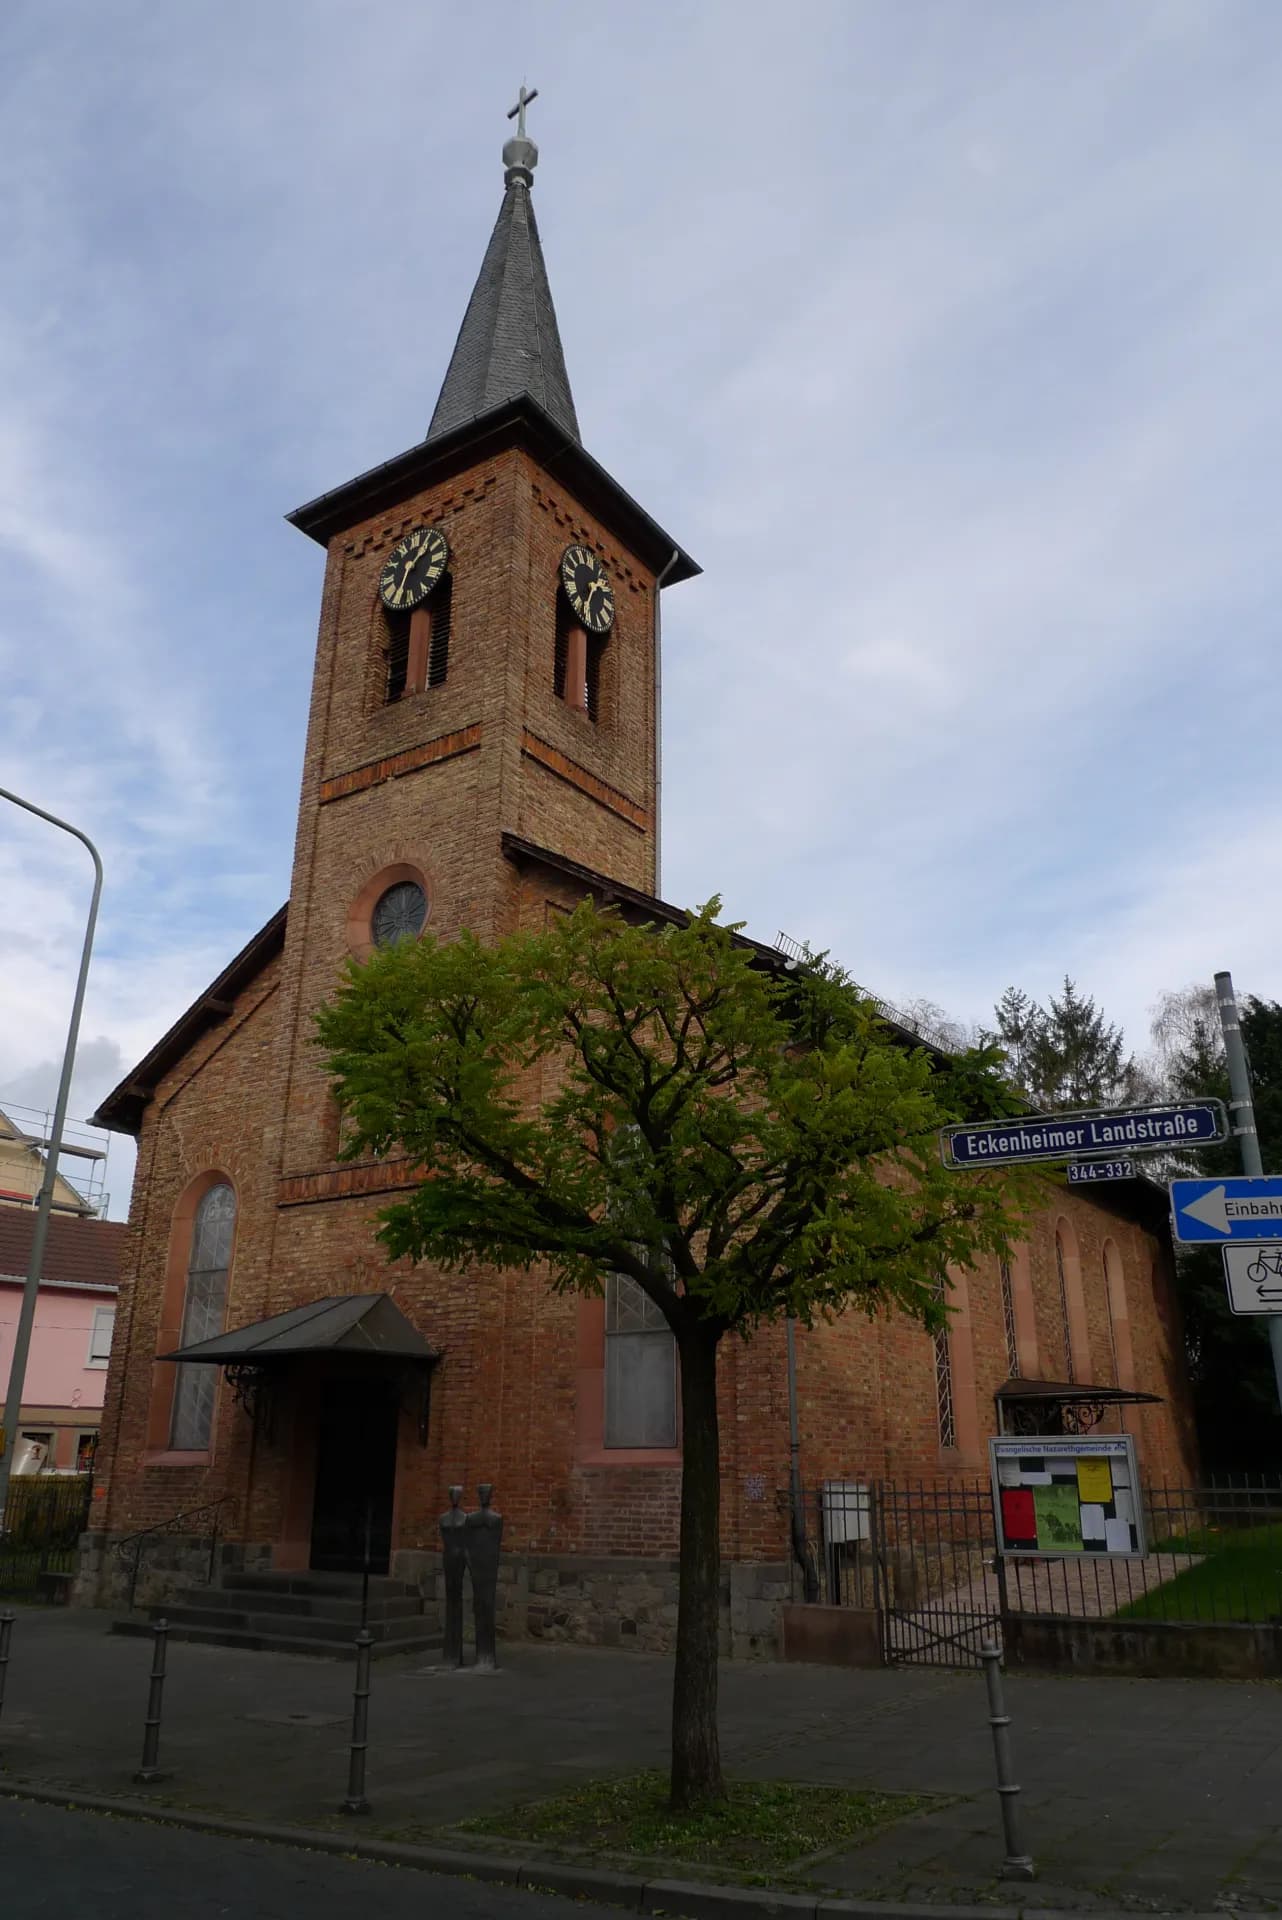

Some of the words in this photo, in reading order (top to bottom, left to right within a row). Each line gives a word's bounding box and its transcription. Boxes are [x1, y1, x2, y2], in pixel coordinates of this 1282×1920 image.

[967, 1128, 1085, 1156] Eckenheimer
[1090, 1114, 1198, 1143] Landstraße
[1070, 1161, 1133, 1181] 344-332
[1224, 1201, 1282, 1216] Einbah
